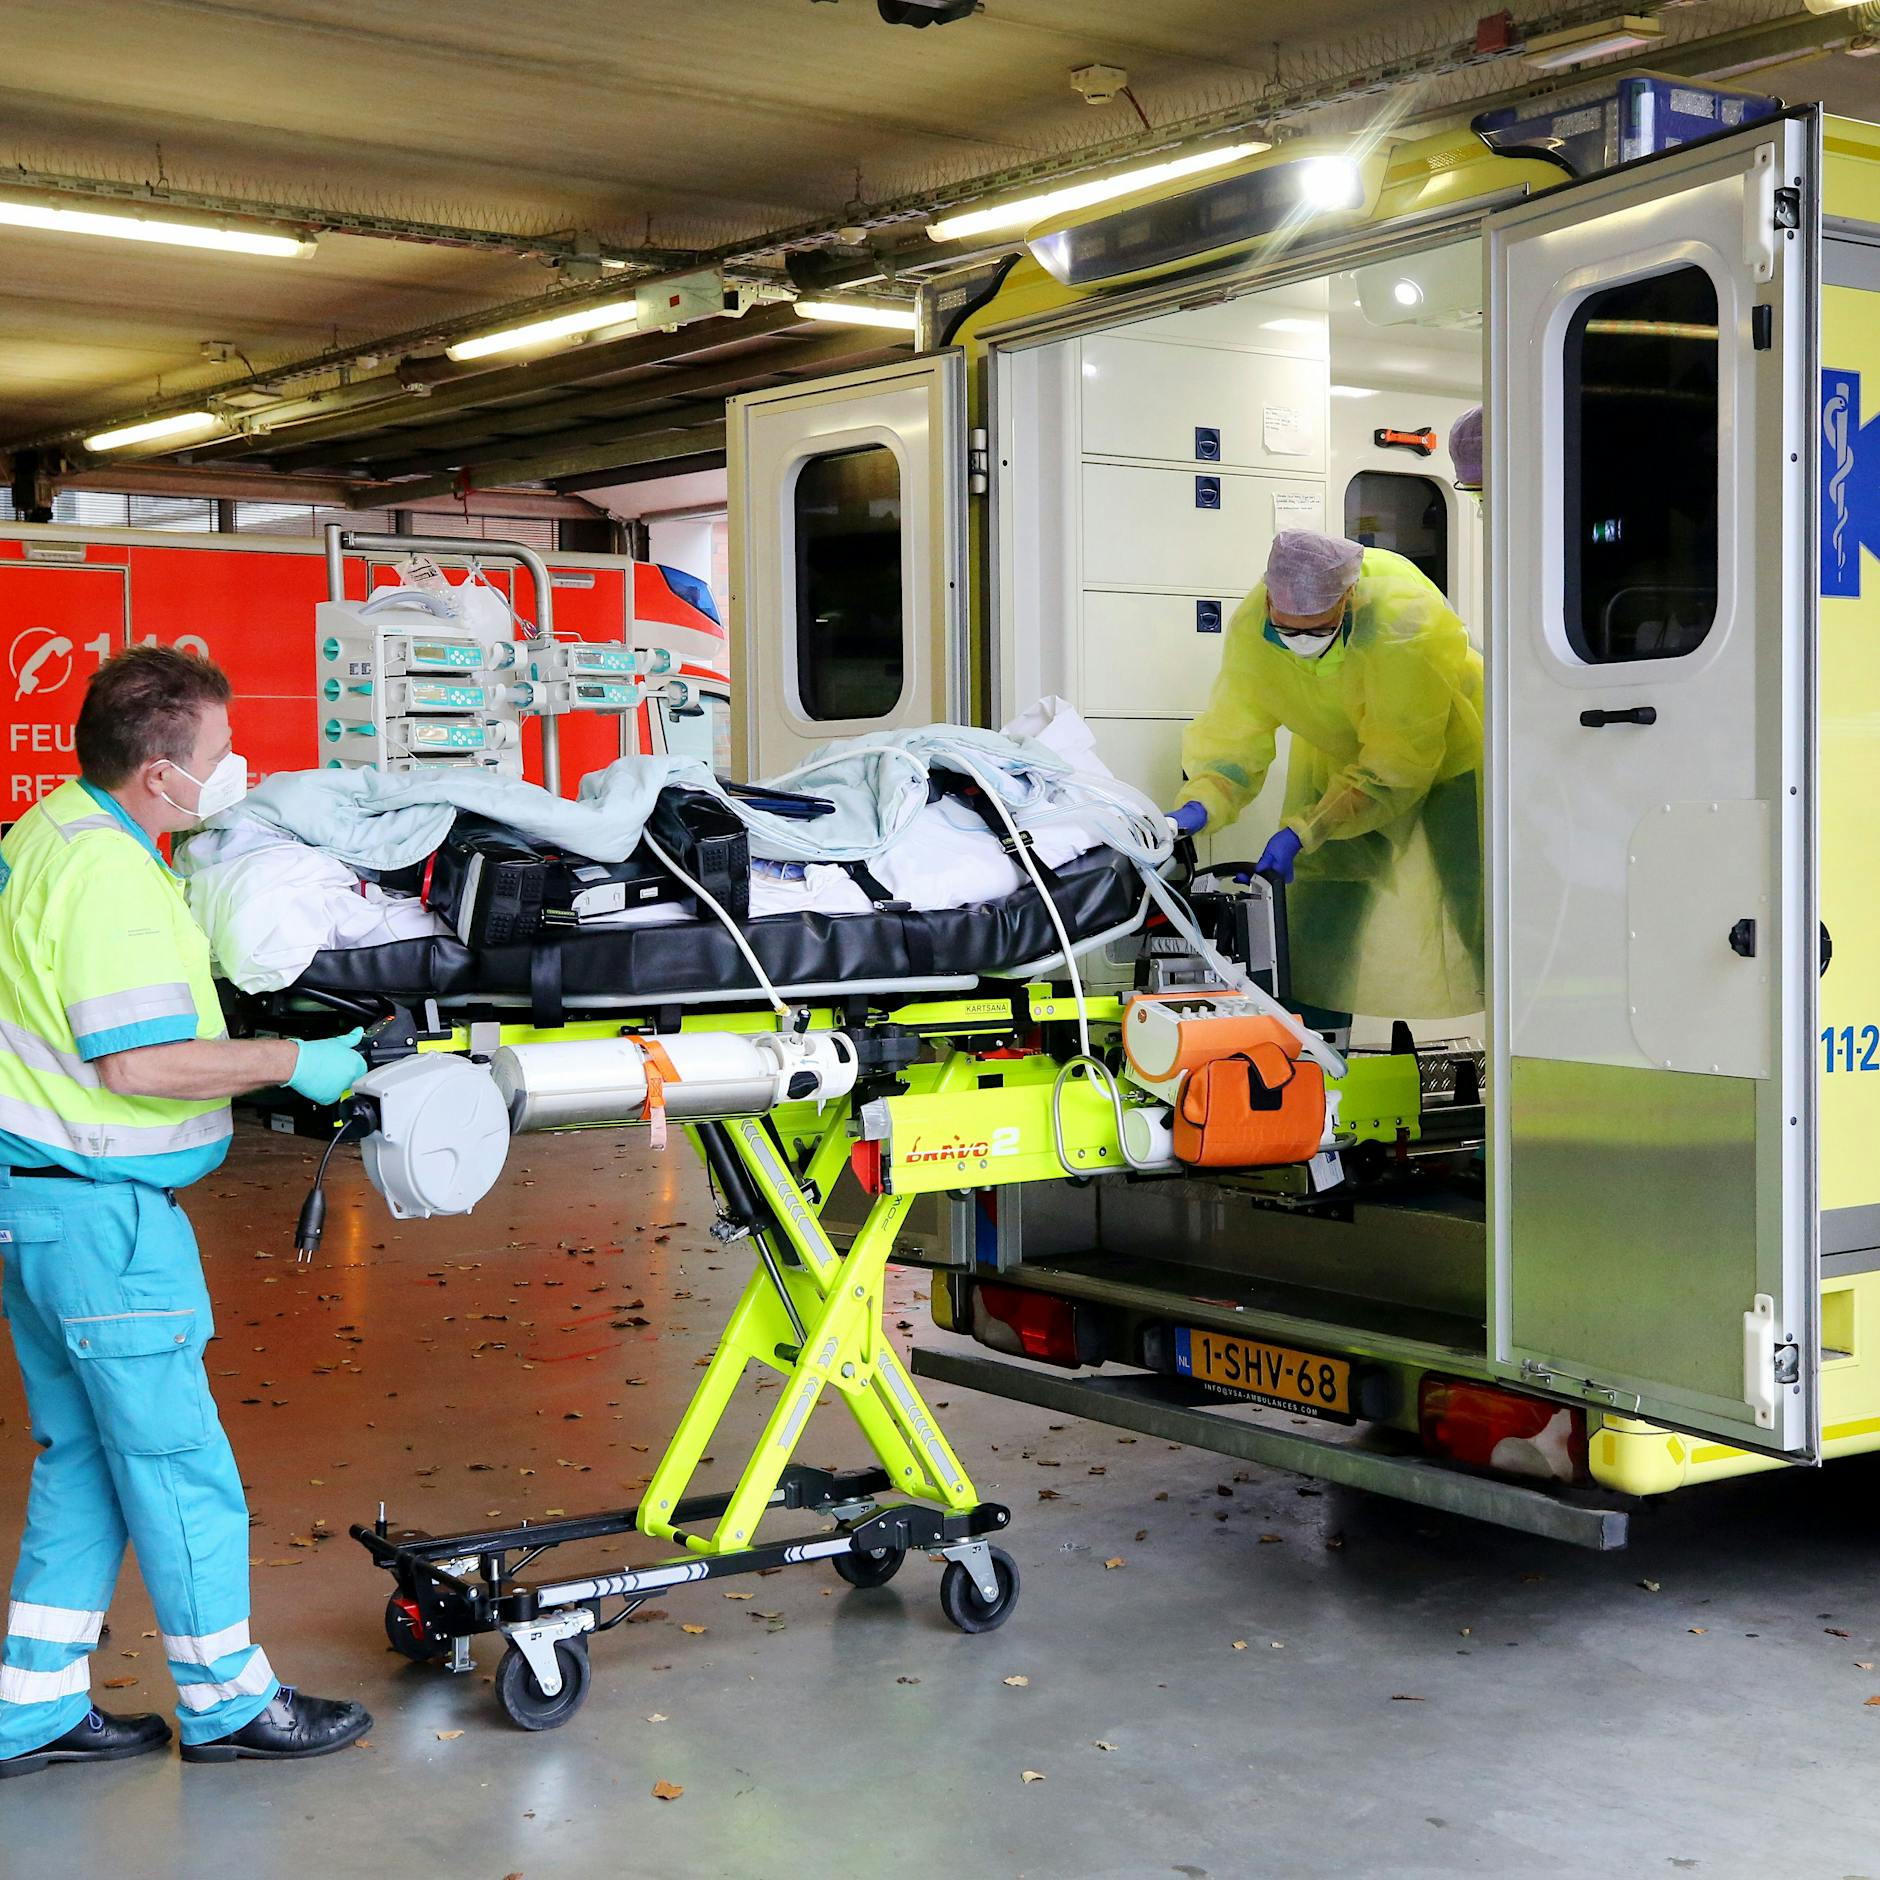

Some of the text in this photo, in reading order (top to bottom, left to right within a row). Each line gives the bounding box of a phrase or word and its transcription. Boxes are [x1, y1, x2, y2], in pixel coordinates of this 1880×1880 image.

[966, 1004, 1007, 1013] KARTSANA
[991, 1127, 1020, 1157] 2
[1178, 1355, 1190, 1368] NL
[1202, 1338, 1337, 1403] 1-SHV-68
